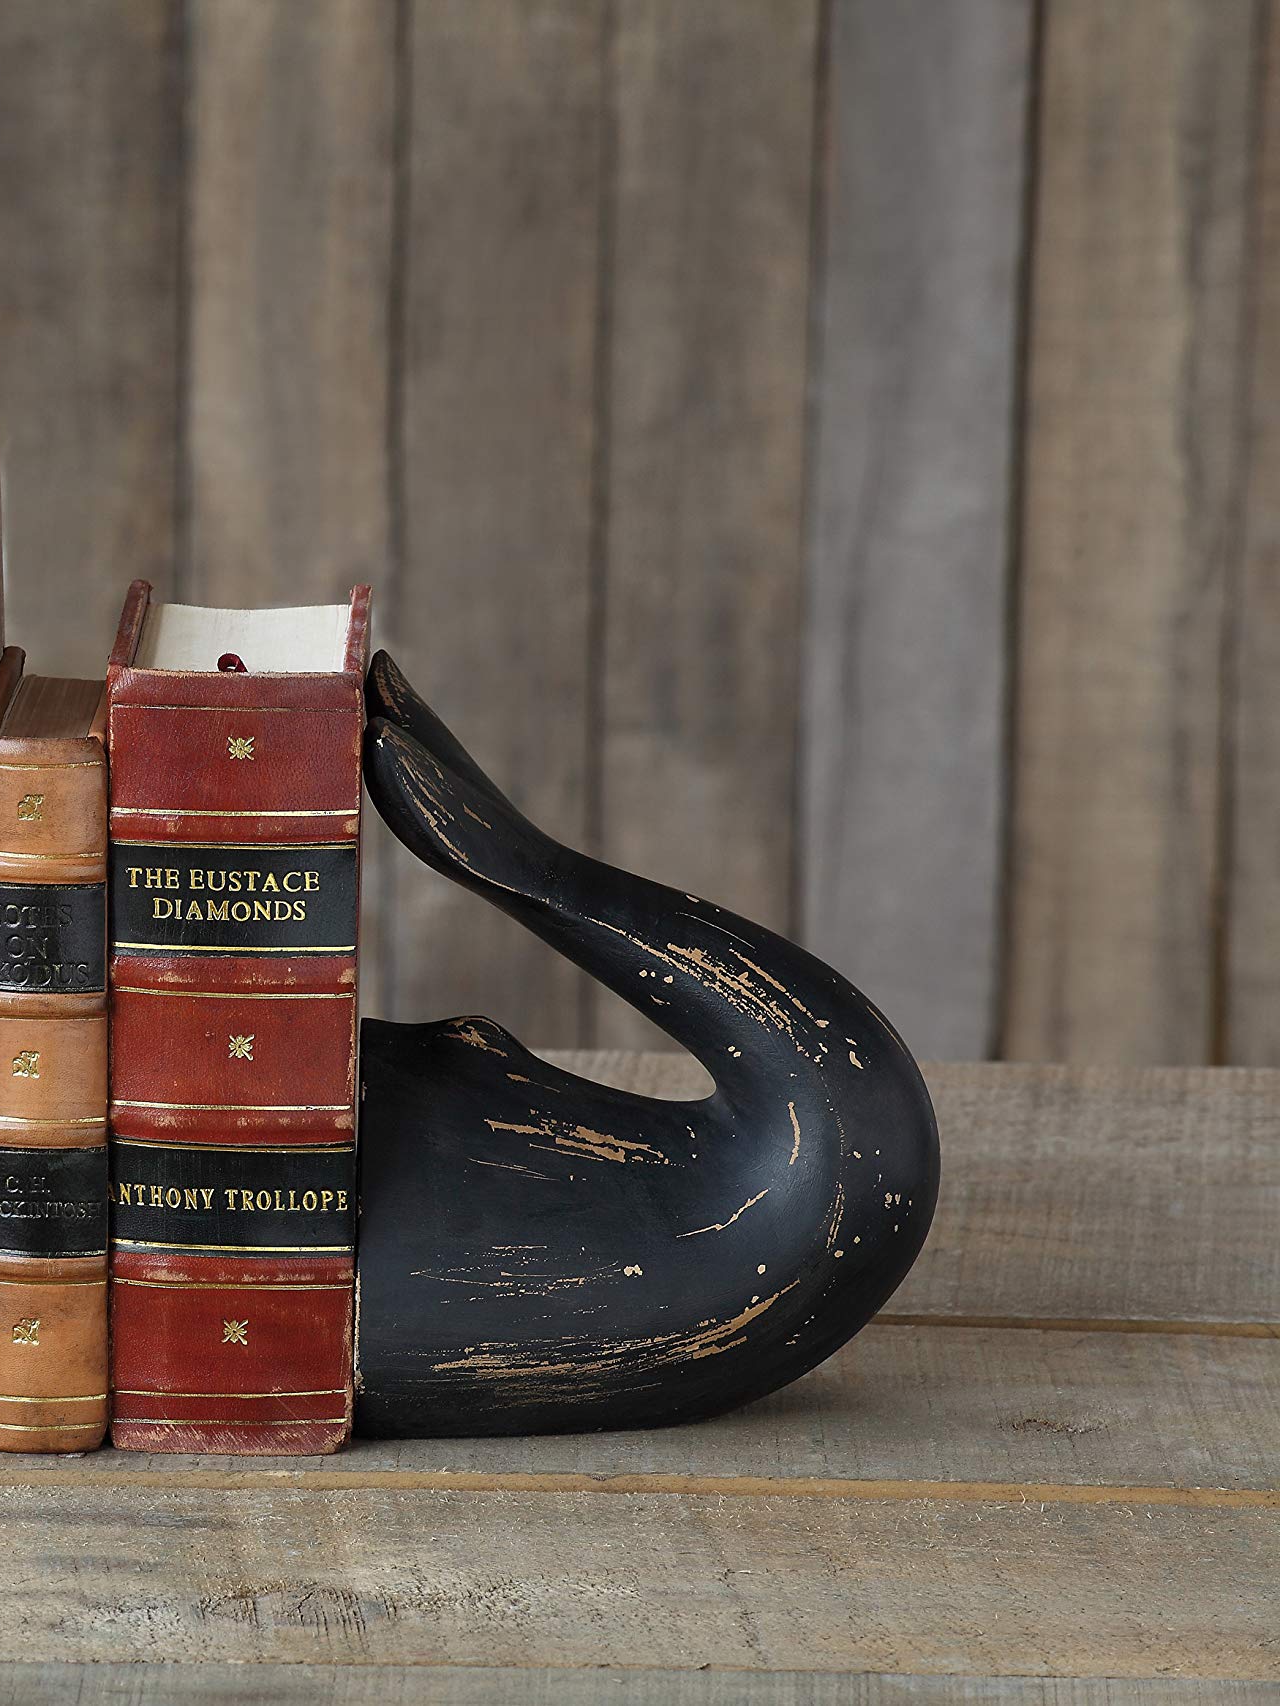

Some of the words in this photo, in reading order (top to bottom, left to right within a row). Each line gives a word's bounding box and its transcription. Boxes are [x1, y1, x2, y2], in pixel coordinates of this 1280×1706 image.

[125, 867, 180, 889] THE
[189, 868, 320, 893] EUSTACE
[152, 897, 306, 922] DIAMONDS
[6, 935, 50, 959] ON
[107, 1182, 215, 1210] ANTHONY
[224, 1189, 348, 1211] TROLLOPE
